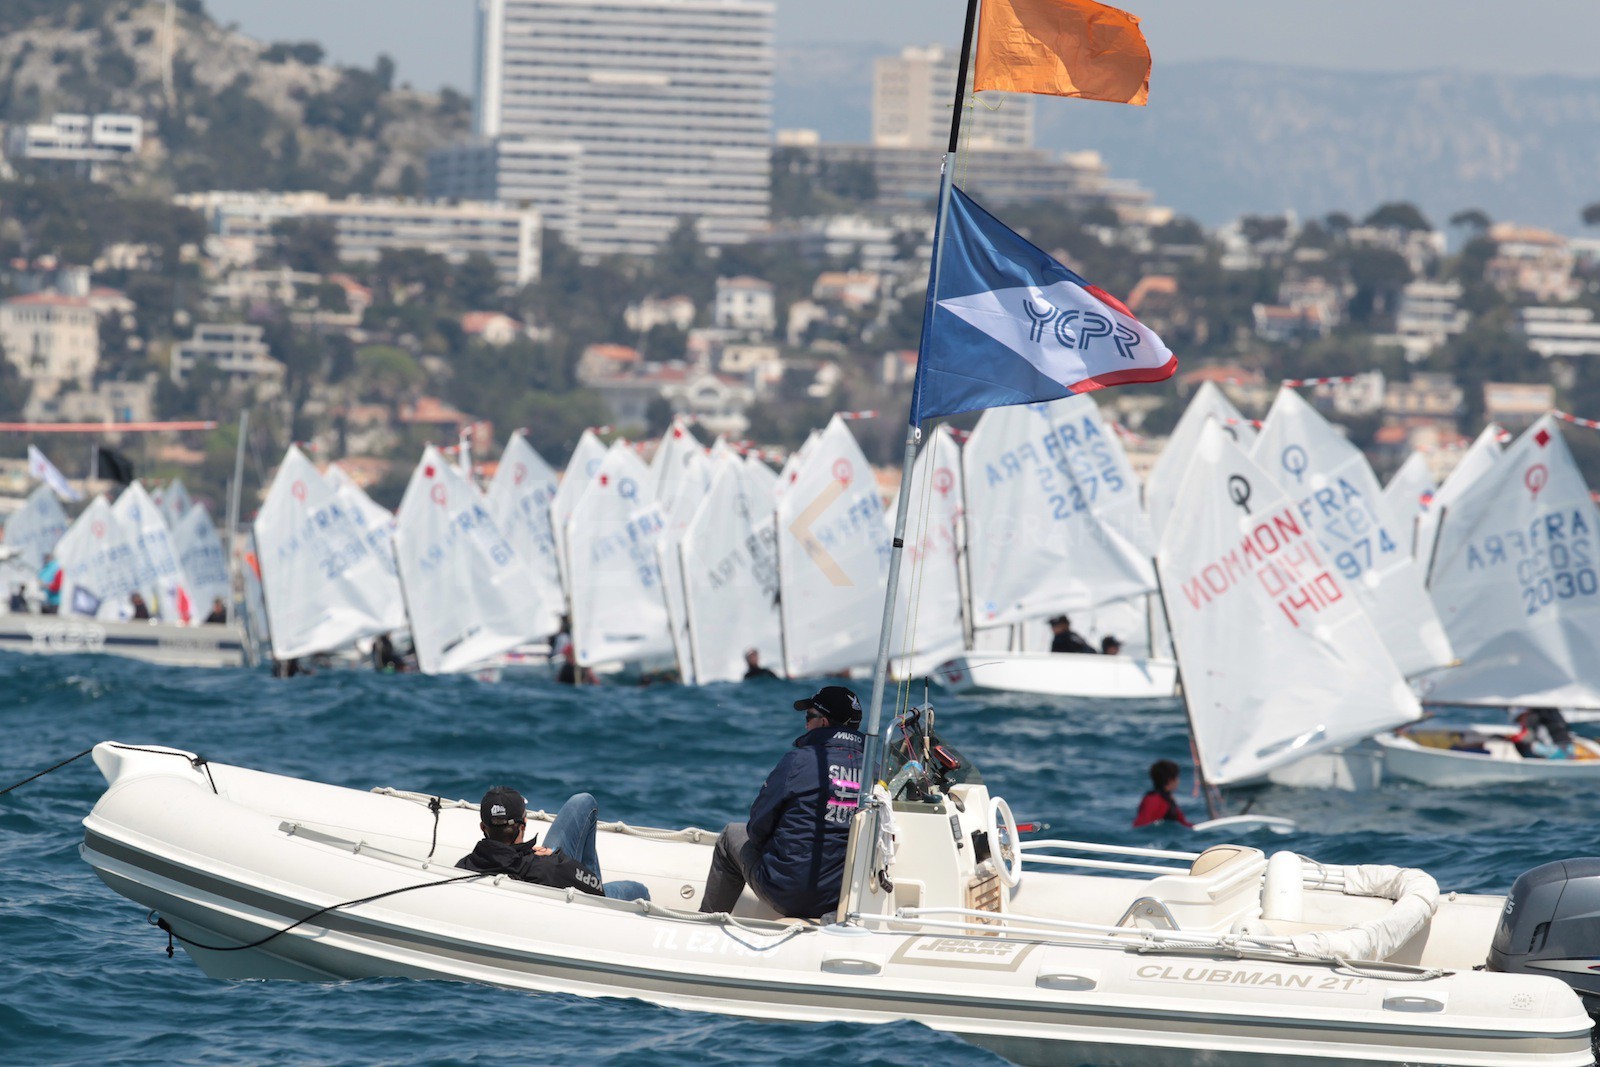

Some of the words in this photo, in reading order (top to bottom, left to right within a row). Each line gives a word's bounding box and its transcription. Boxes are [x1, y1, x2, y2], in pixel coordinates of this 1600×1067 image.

[1023, 299, 1141, 360] YCPR
[1043, 415, 1099, 459] FRA
[1049, 466, 1124, 520] 2275
[1299, 477, 1361, 528] FRA
[1241, 508, 1302, 563] MON
[1530, 510, 1589, 548] FRA
[1278, 572, 1343, 628] 1410
[1523, 568, 1598, 616] 2030
[832, 731, 862, 743] MUSTO
[575, 867, 603, 892] YCPR
[652, 927, 679, 950] TL
[917, 938, 1017, 951] JOKER
[935, 946, 1013, 956] BOAT
[1136, 965, 1313, 988] CLUBMAN
